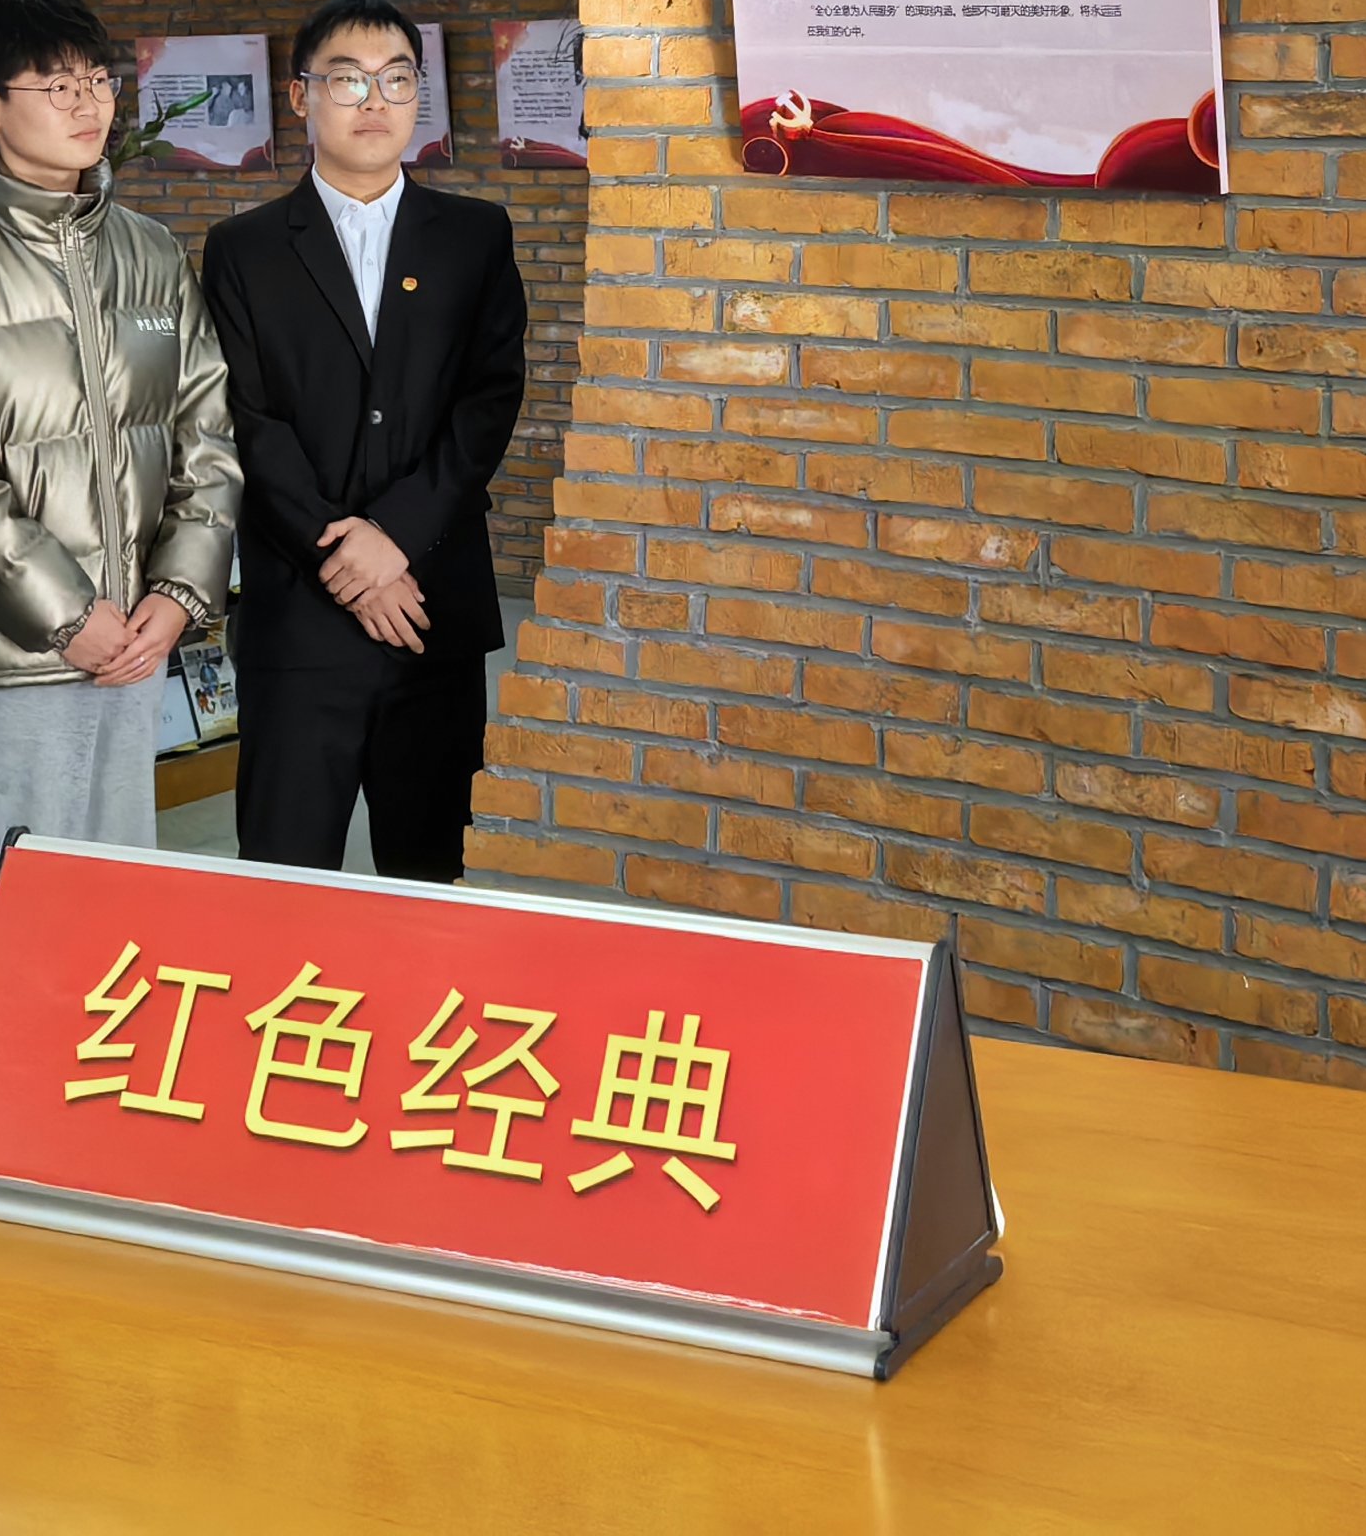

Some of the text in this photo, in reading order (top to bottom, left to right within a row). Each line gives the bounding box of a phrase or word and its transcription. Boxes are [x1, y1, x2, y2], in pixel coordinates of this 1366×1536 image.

[136, 317, 175, 331] PEACE
[64, 940, 738, 1214] 红色经典
